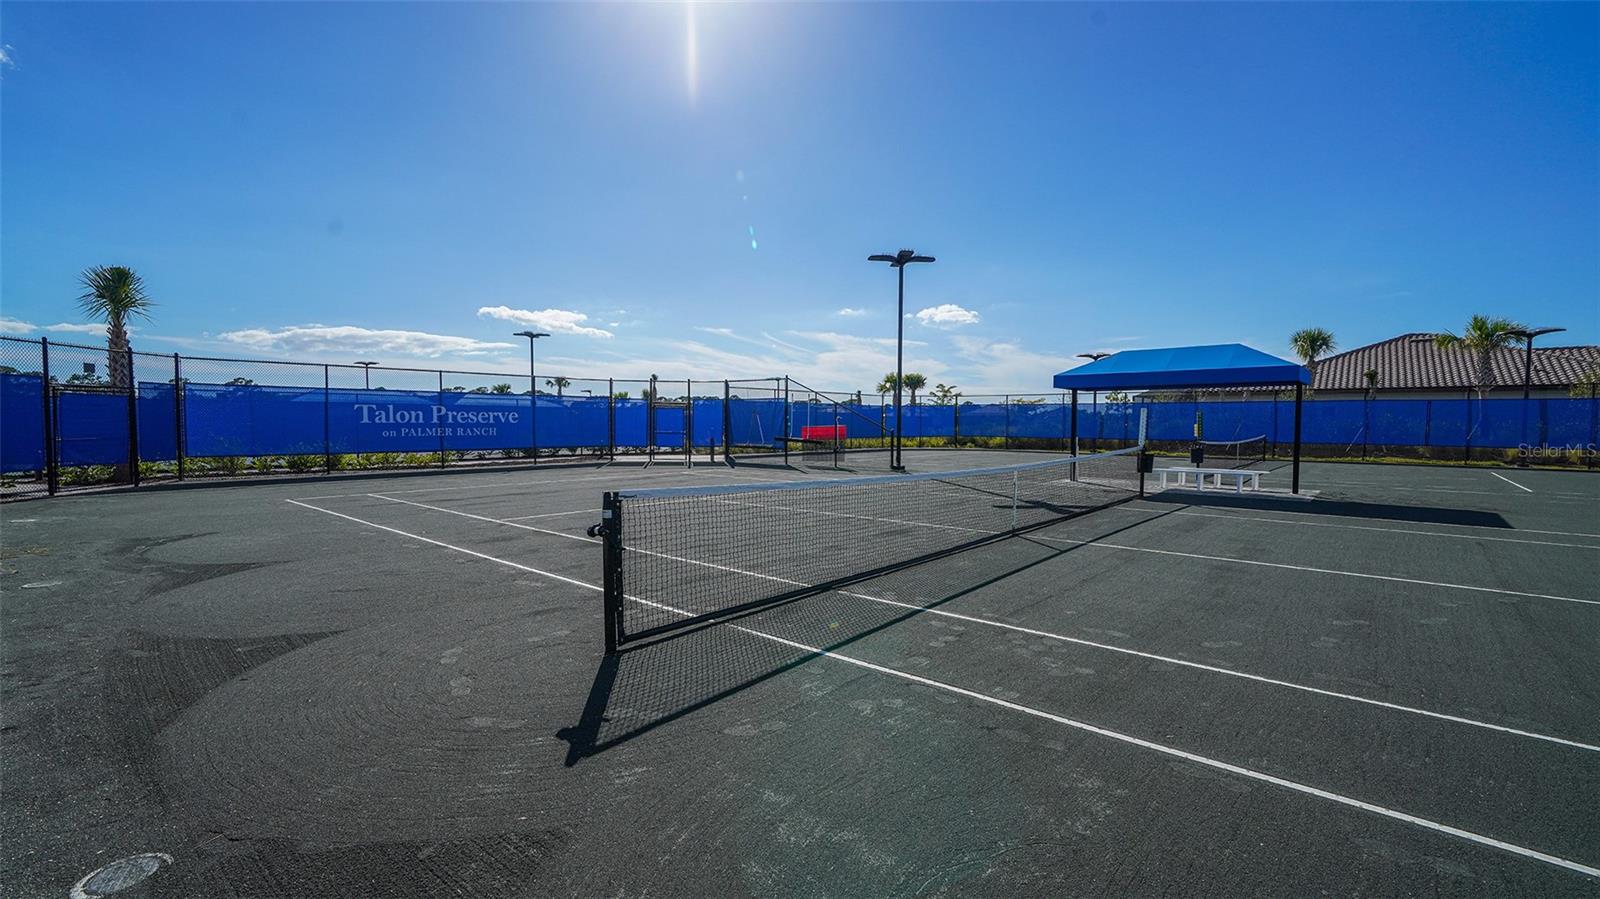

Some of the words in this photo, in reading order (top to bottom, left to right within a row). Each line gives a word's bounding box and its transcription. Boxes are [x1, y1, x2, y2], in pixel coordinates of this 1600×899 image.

[354, 404, 424, 424] Talon
[430, 405, 519, 424] Preserve
[382, 429, 397, 437] on
[401, 427, 453, 437] PALMER
[457, 427, 497, 437] RANCH
